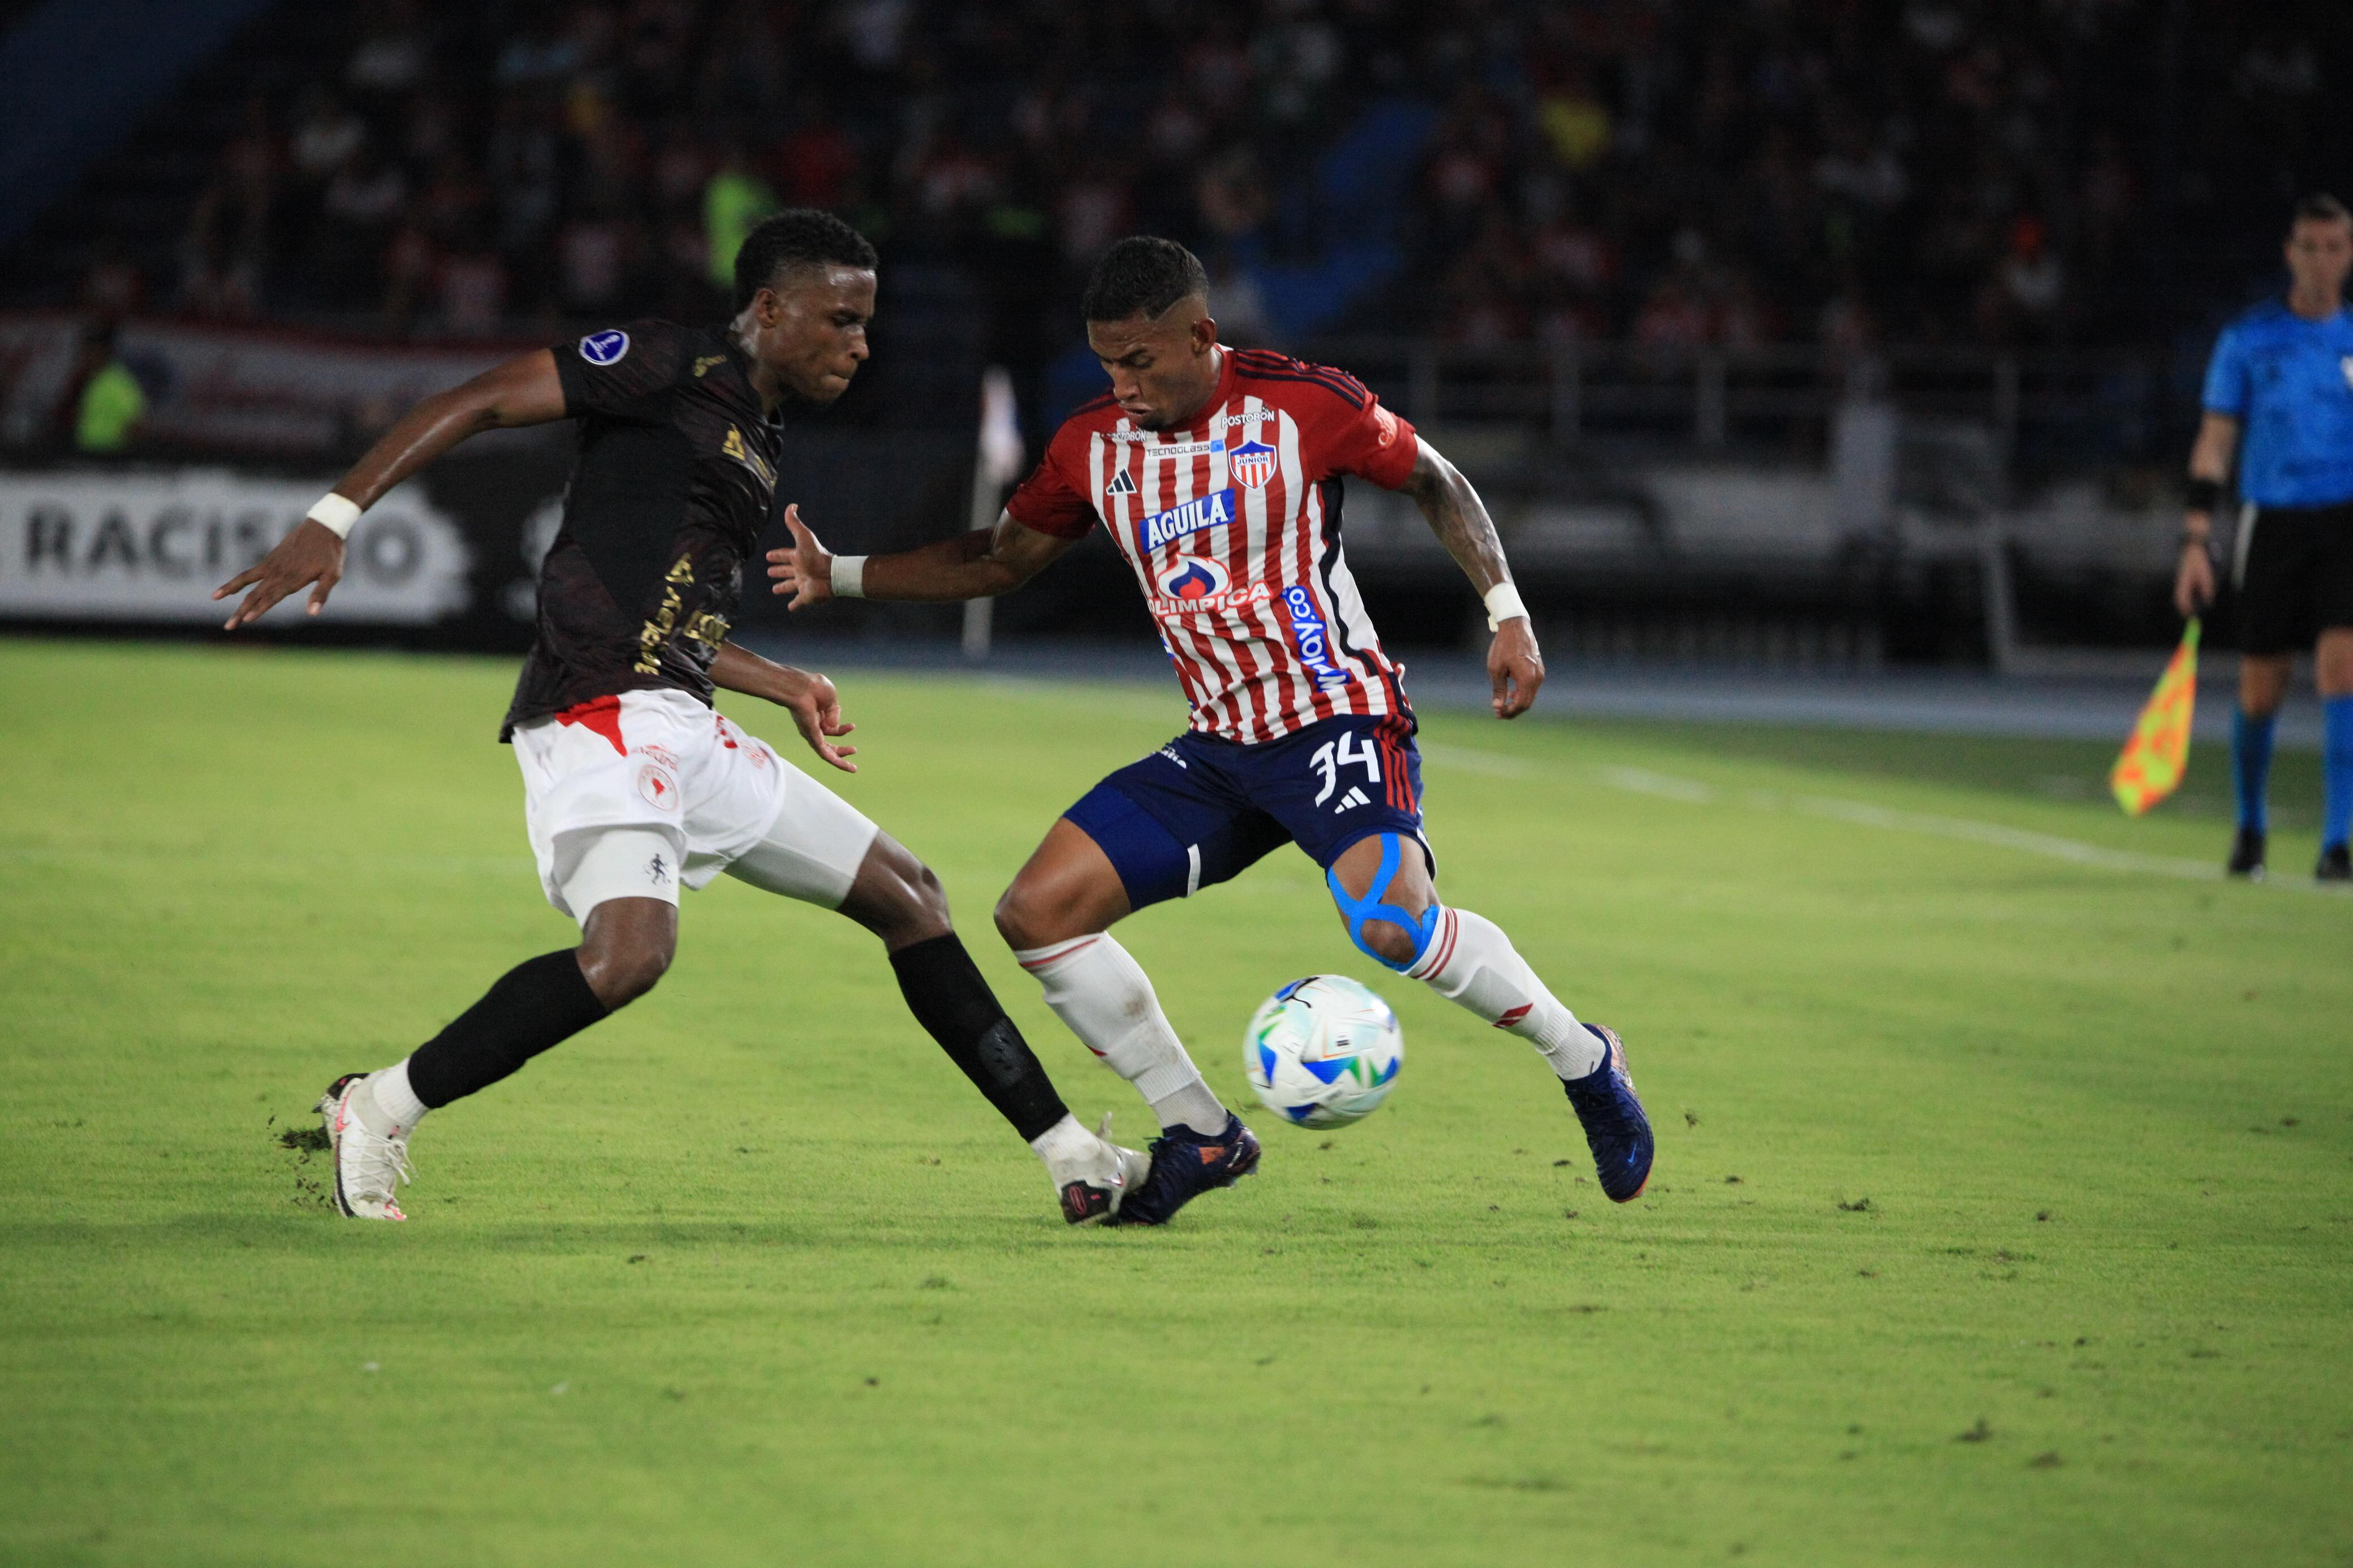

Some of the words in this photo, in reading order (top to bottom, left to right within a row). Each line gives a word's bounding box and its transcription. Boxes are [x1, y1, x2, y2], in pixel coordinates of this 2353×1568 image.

[1148, 493, 1229, 550] AGUILA
[1149, 581, 1273, 616] OLIMPICA
[1309, 731, 1381, 807] 34
